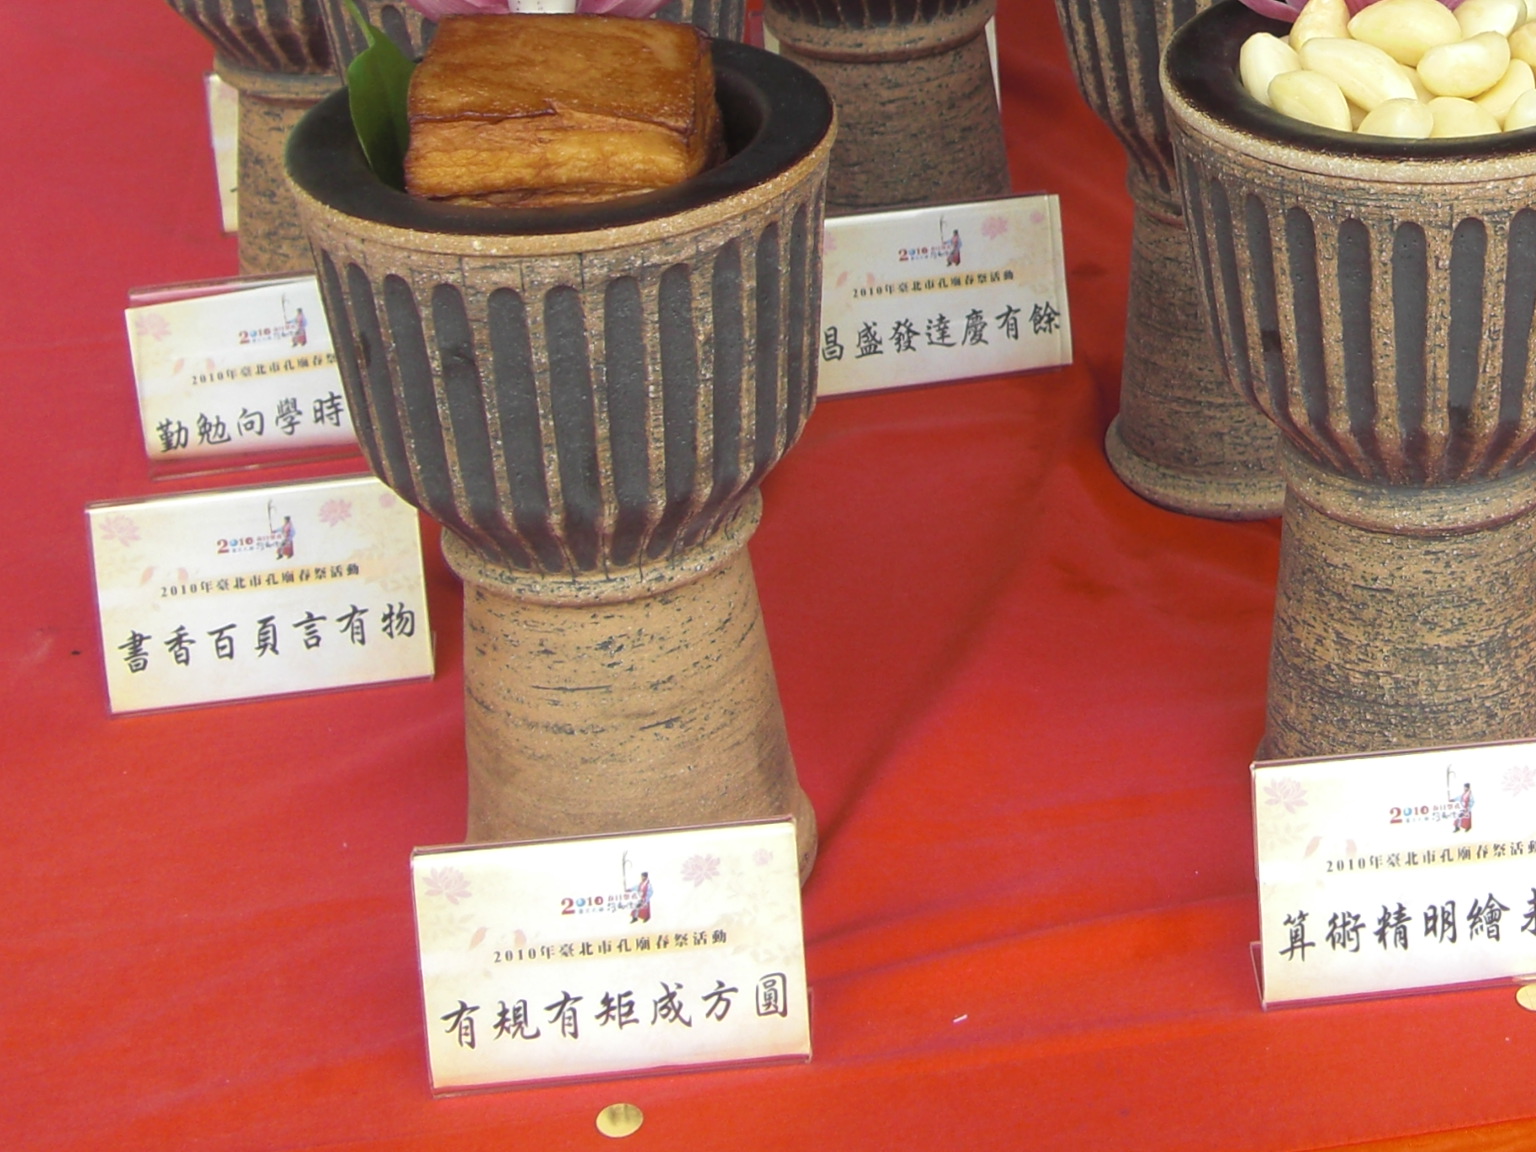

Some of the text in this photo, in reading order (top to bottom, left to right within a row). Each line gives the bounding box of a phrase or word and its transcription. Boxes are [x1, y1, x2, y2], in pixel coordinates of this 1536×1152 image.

[853, 270, 1014, 298] 2010年臺北市孔廟春祭活動
[821, 301, 1061, 362] 昌盛發達慶有餘
[156, 391, 344, 453] 勤勉向學時
[160, 565, 361, 599] 2010年臺北市孔廟春祭活動
[118, 602, 416, 674] 書香百頁言有物
[494, 929, 728, 964] 2010年臺北市孔廟春祭活動
[439, 972, 789, 1050] 有規有矩成方圓
